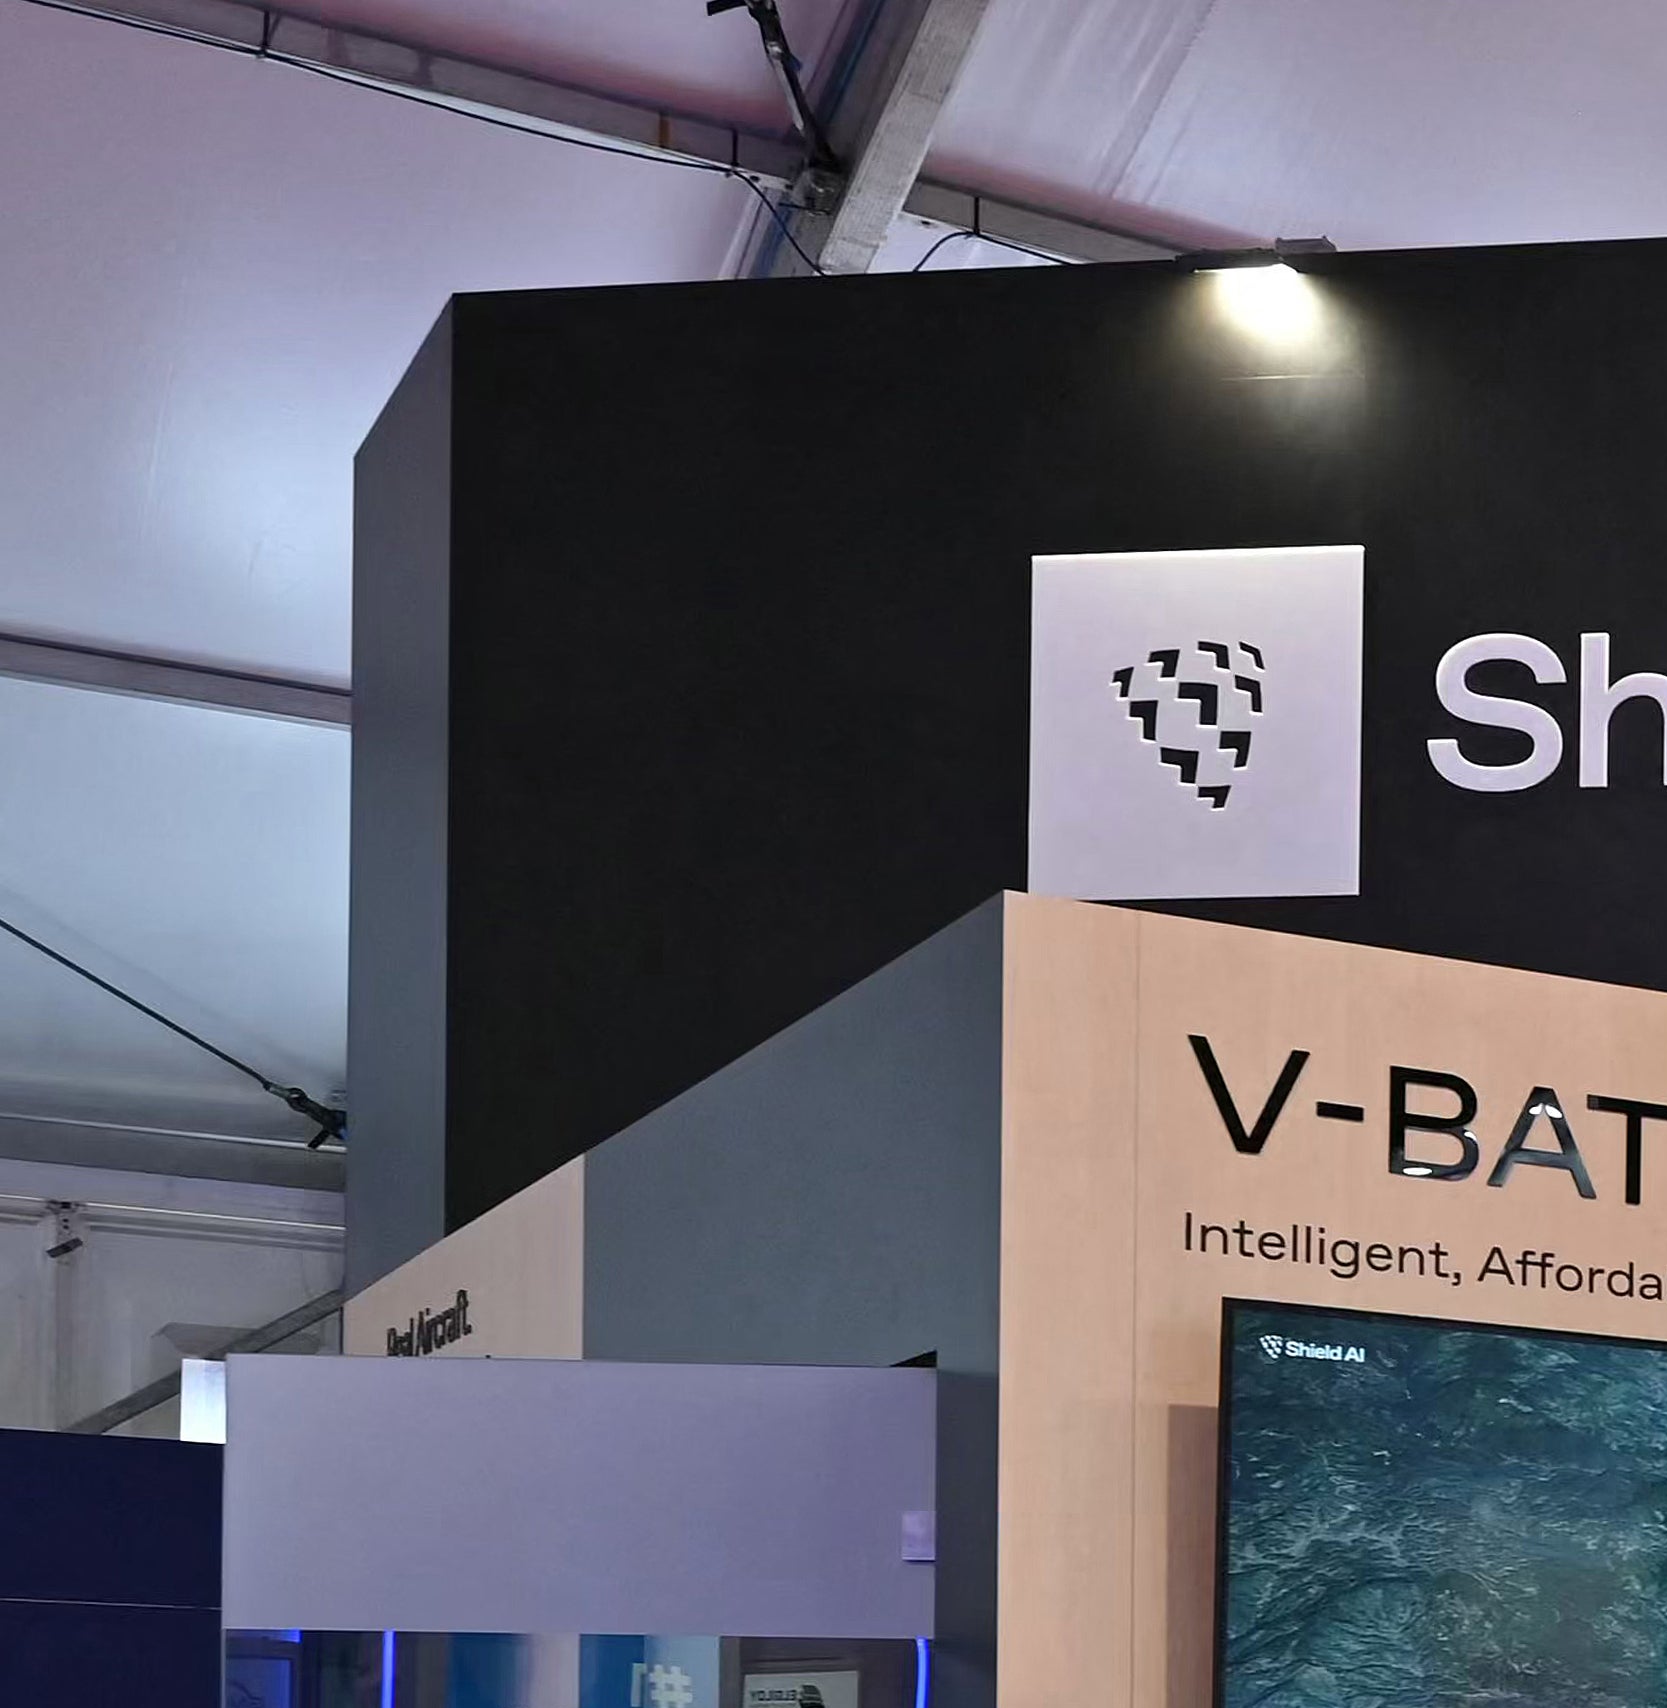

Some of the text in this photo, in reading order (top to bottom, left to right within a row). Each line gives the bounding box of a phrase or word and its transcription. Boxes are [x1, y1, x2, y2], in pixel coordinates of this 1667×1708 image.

[1183, 1211, 1463, 1280] Intelligent,
[415, 1289, 472, 1357] Aircraft.
[1284, 1340, 1366, 1363] Shield AI
